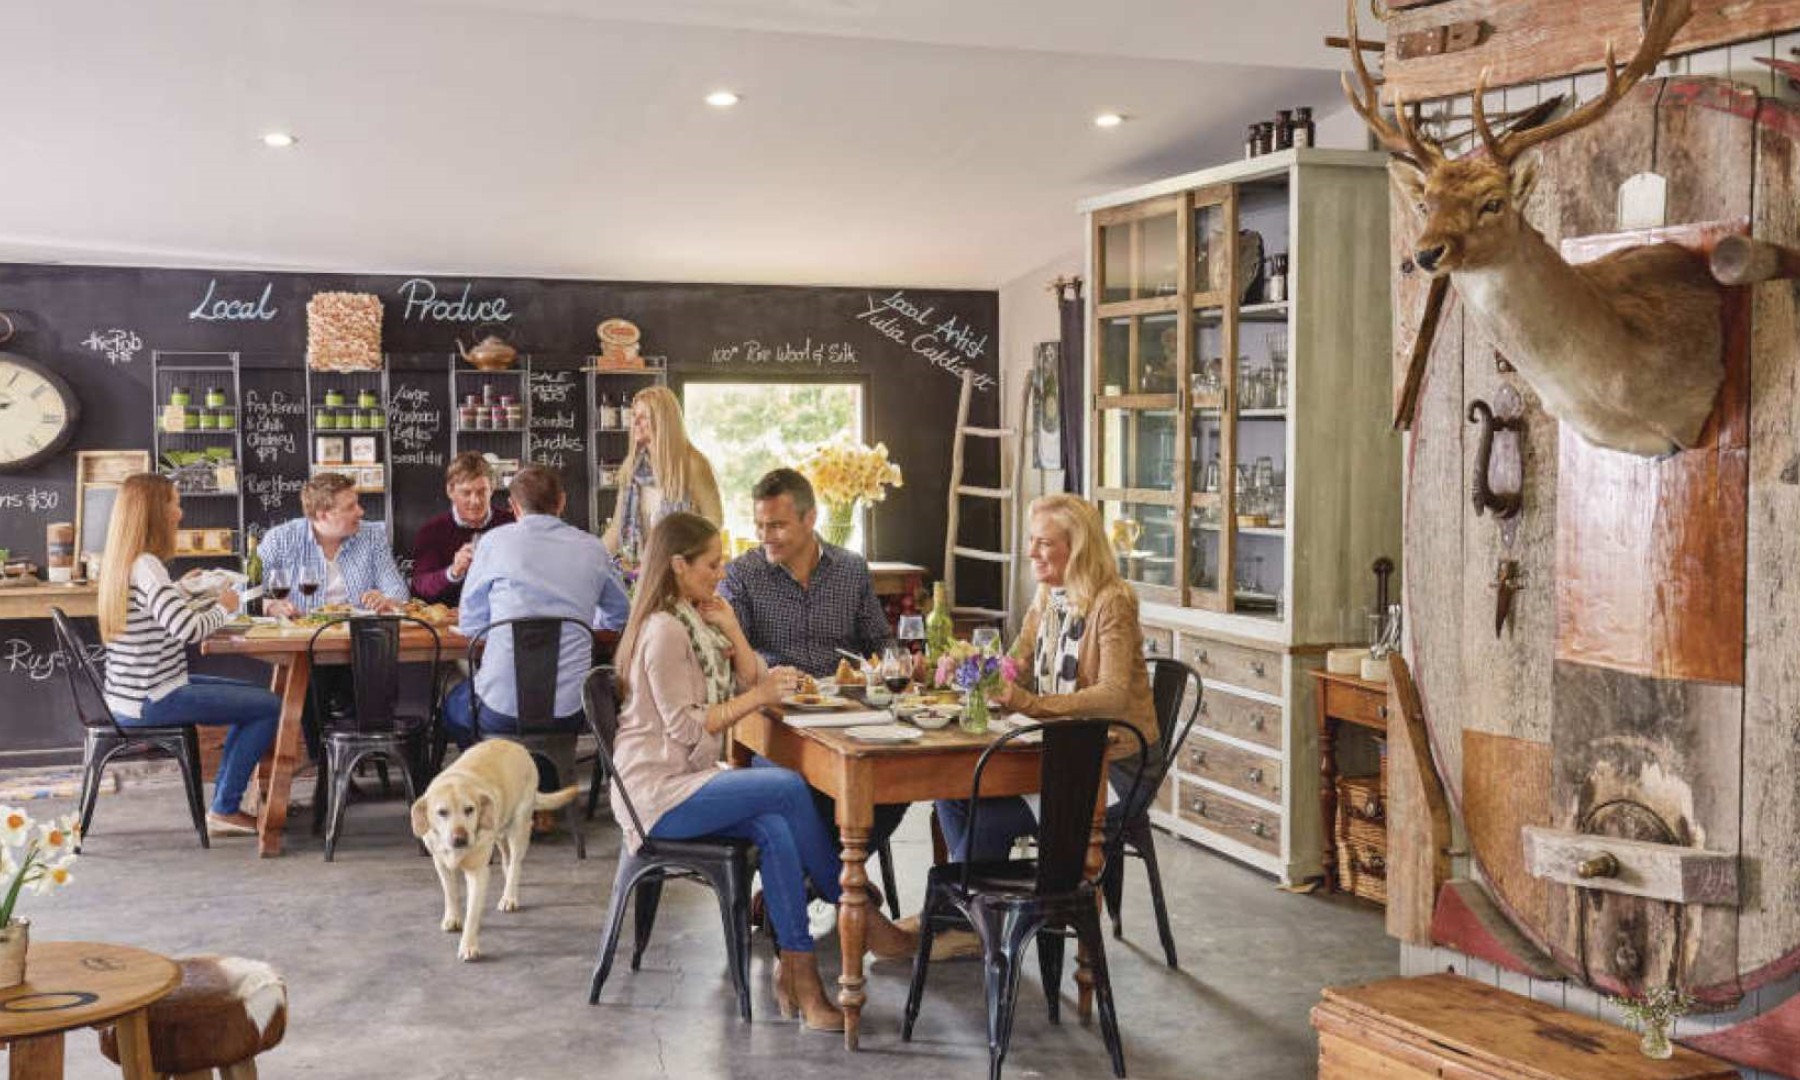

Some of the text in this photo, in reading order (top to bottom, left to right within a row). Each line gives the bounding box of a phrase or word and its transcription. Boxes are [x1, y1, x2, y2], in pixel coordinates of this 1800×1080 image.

[188, 277, 513, 323] Local Produce
[881, 290, 988, 359] Local Artist
[828, 341, 859, 364] Silk
